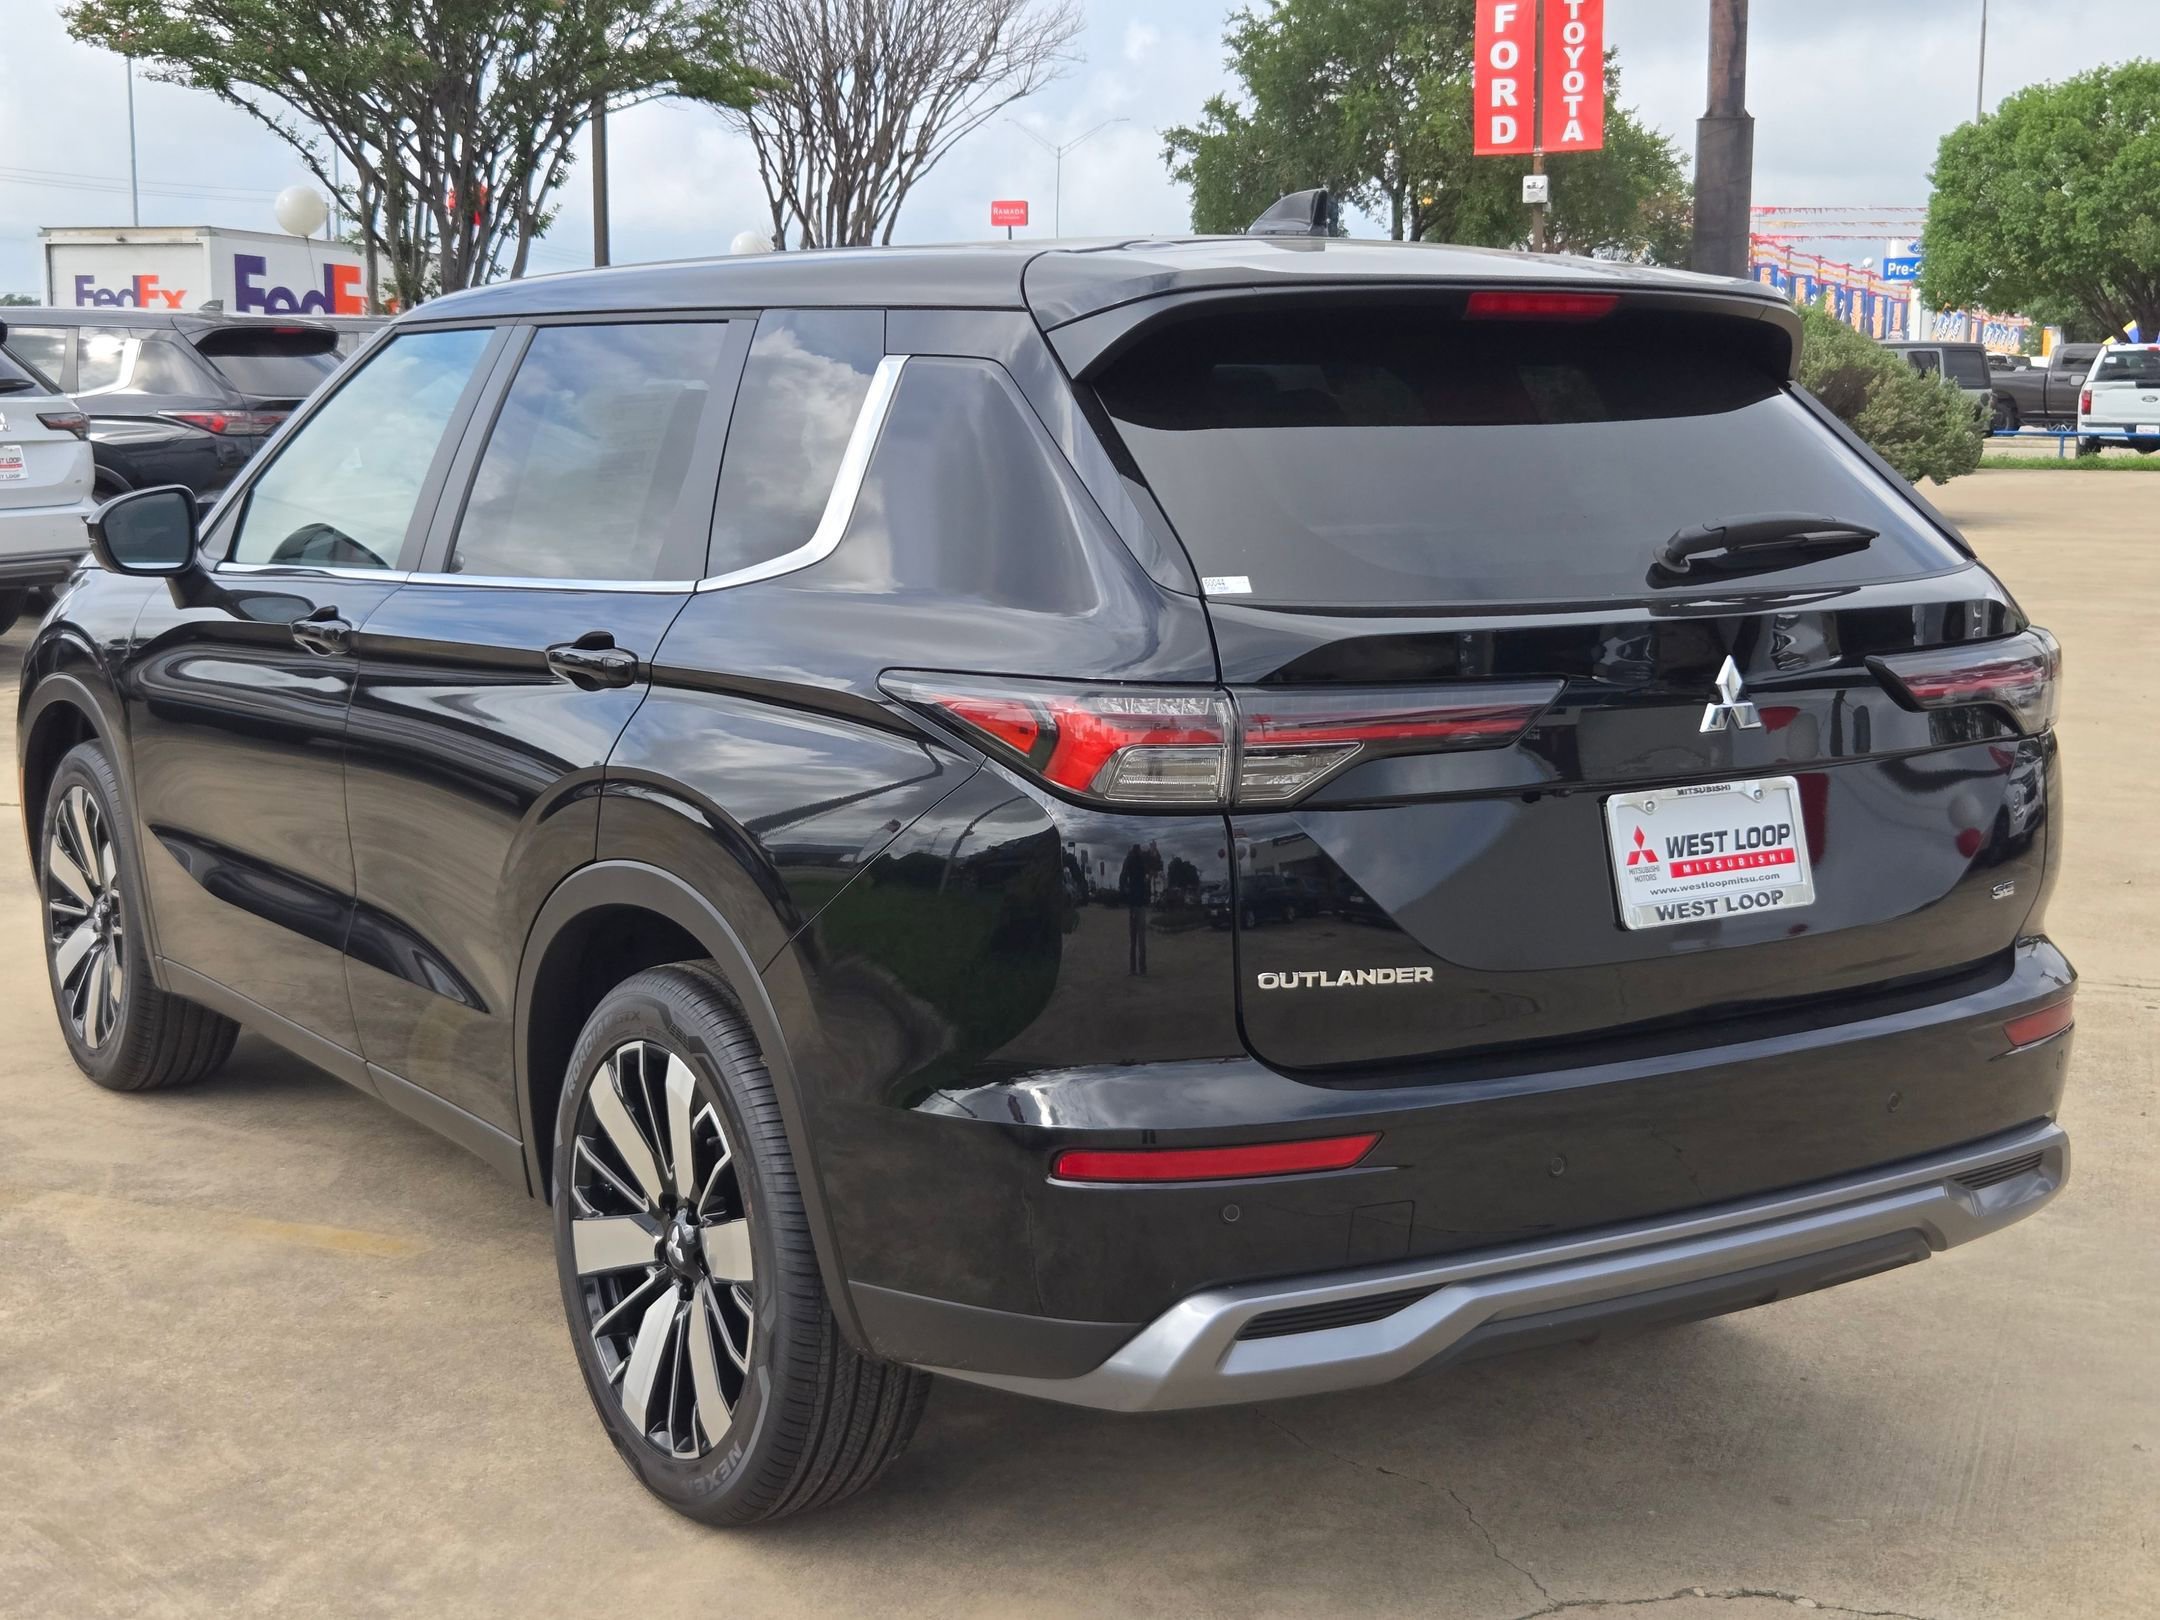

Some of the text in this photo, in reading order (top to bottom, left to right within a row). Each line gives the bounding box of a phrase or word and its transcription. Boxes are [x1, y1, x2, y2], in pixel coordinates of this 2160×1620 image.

[1490, 4, 1518, 144] FORD
[1561, 0, 1585, 142] TOYOTA
[993, 207, 1025, 216] RAMADA
[74, 274, 187, 309] FedEx
[1677, 784, 1731, 796] MITSUBISHI
[1665, 823, 1791, 859] WEST LOOP
[1628, 866, 1661, 876] MITSUBISHI
[1683, 853, 1785, 875] MITSUBISHI
[1634, 873, 1657, 883] MOTORS
[1650, 872, 1780, 896] www.westloopmitsu.com
[1991, 880, 2015, 900] SE
[1655, 889, 1784, 921] WEST LOOP
[1257, 966, 1434, 990] OUTLANDER
